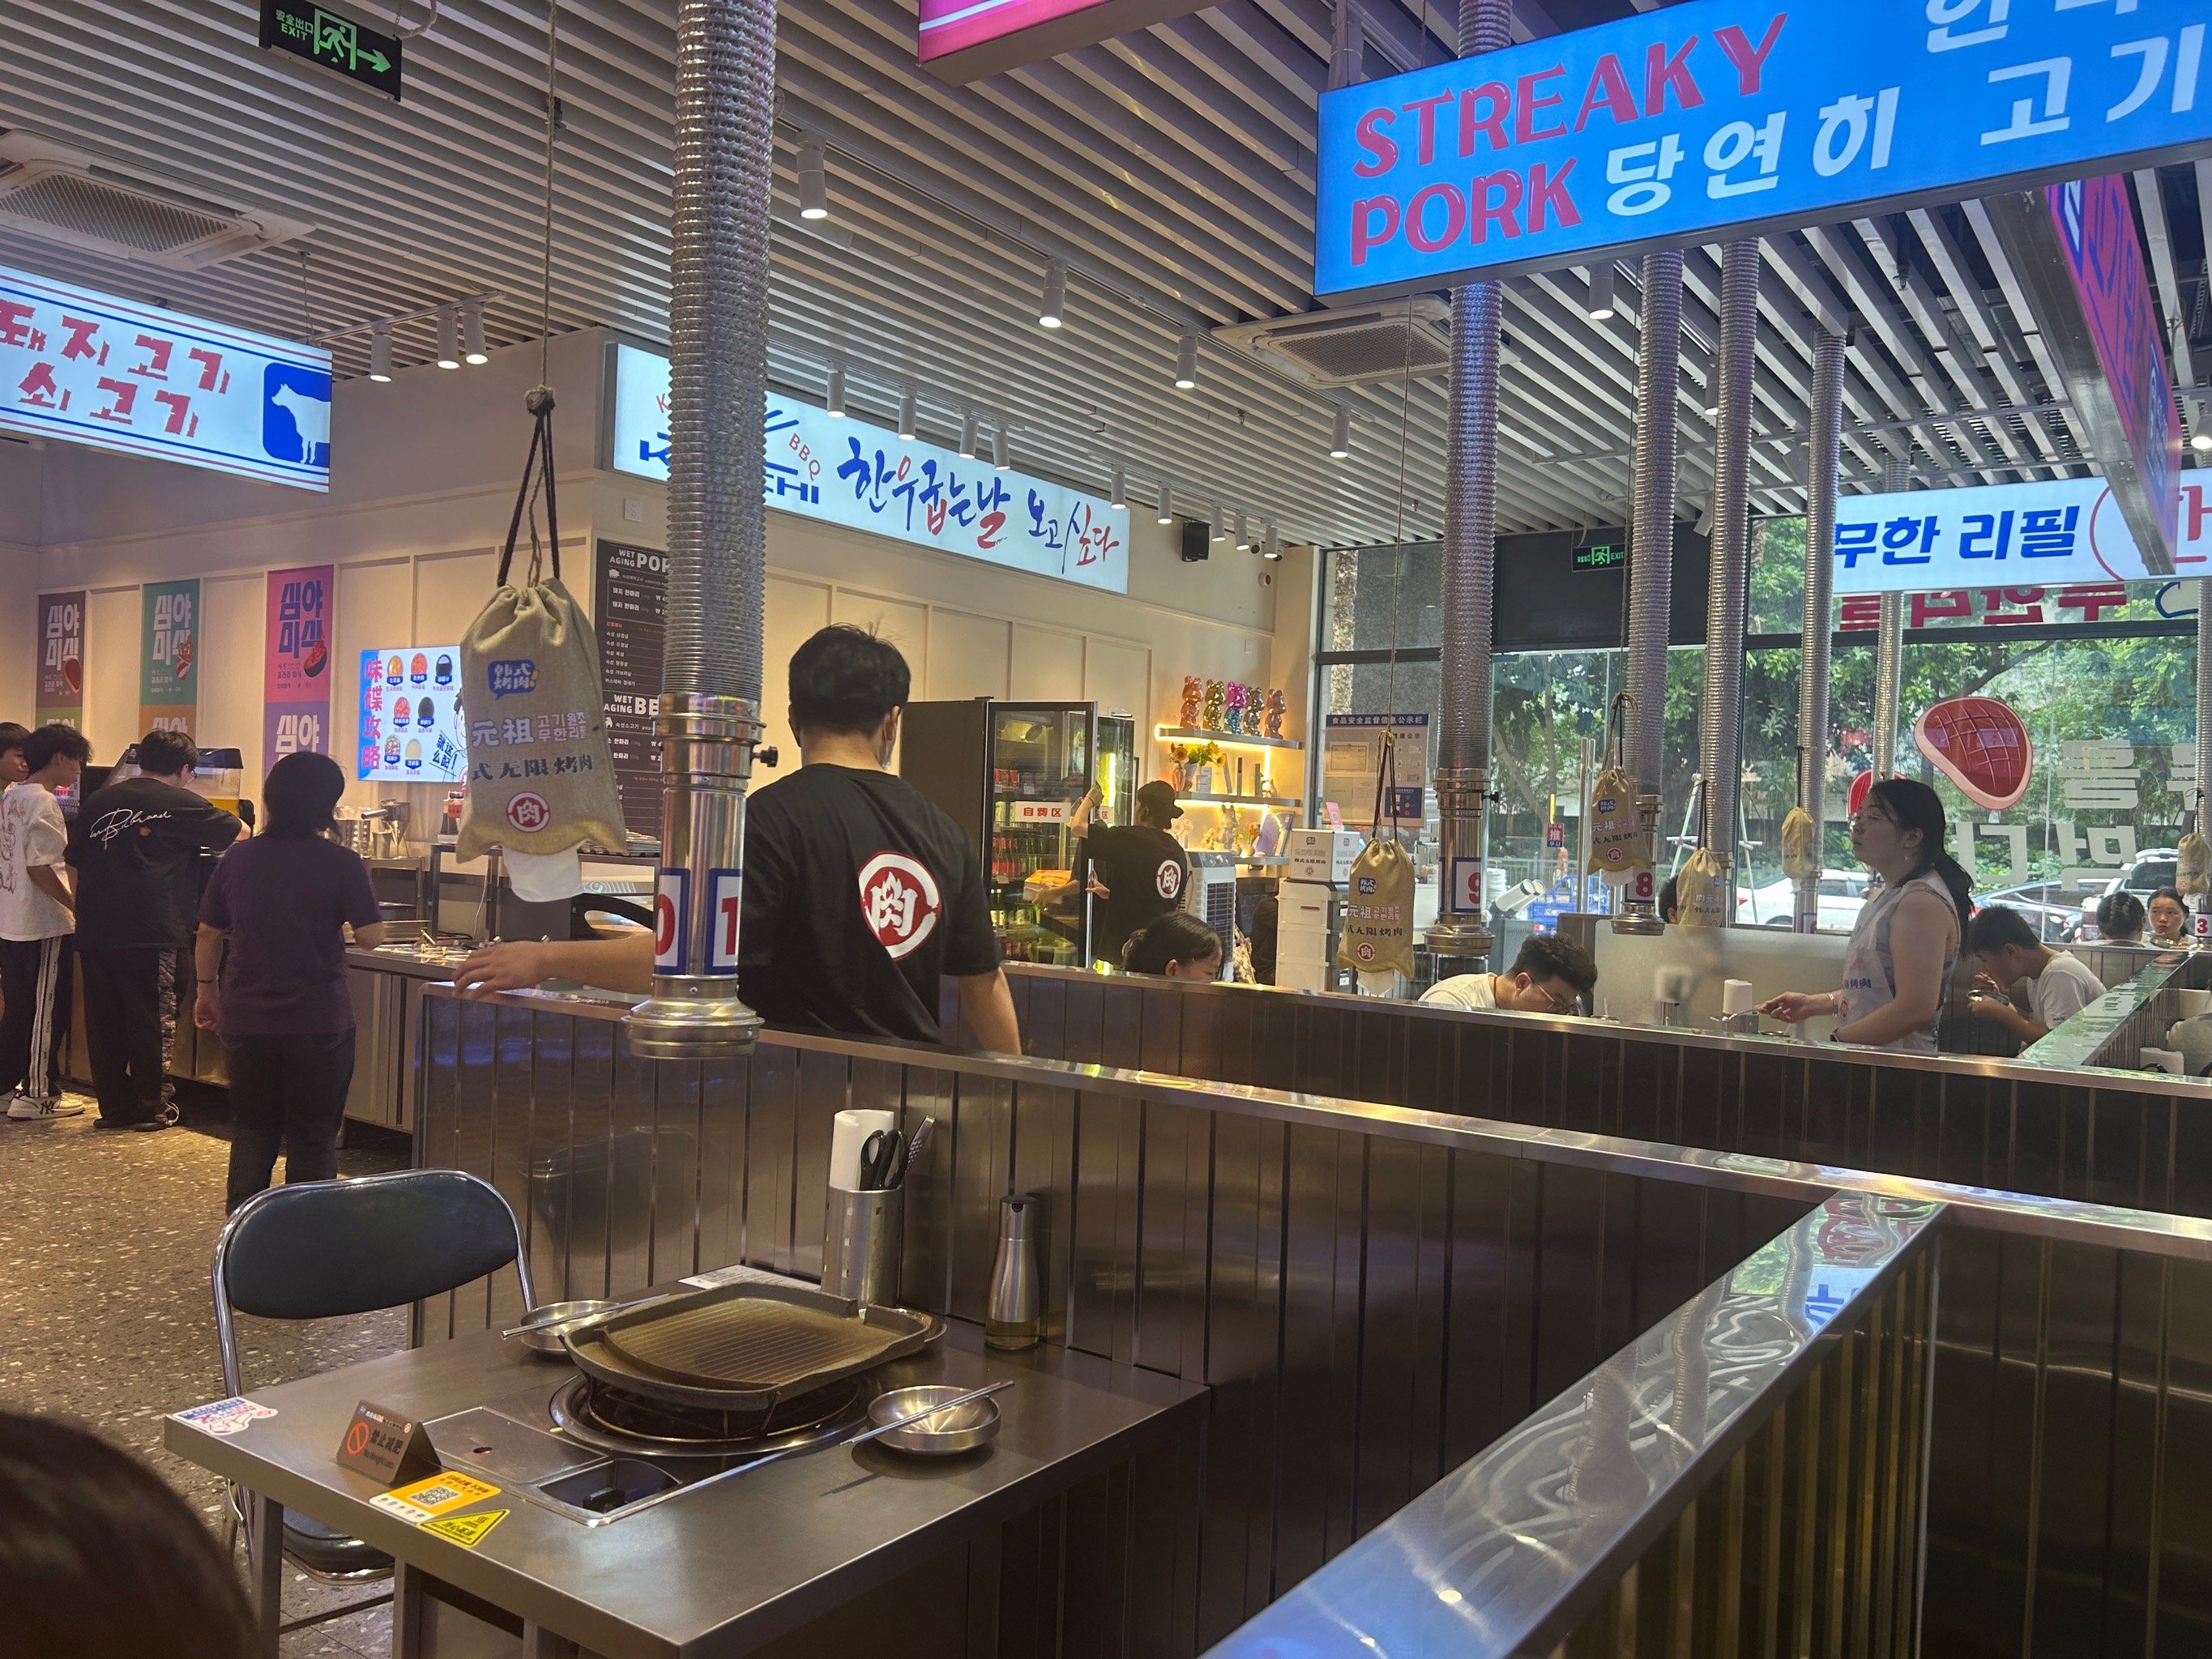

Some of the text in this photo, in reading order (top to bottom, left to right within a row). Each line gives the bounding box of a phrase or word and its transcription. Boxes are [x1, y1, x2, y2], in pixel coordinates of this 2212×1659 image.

[276, 9, 314, 35] 安全出口
[281, 23, 308, 41] EXIT
[1353, 13, 1787, 177] STREAKY
[1980, 23, 2206, 146] 고기
[1606, 86, 1900, 216] 당연히
[1351, 157, 1582, 267] PORK
[788, 432, 821, 481] BBQ
[1834, 505, 2080, 569] 무한 리필
[609, 557, 635, 567] AGING
[619, 548, 635, 558] WET
[1611, 552, 1625, 561] EXIT
[493, 663, 532, 677] 韩式
[604, 703, 632, 714] AGING
[613, 694, 633, 704] WET
[1332, 716, 1423, 725] 食品安全监督信息公示栏
[472, 718, 534, 746] 元祖
[472, 754, 593, 781] 式无限烤肉
[1023, 807, 1061, 817] 自费区
[1635, 872, 1653, 898] 8
[1348, 905, 1372, 919] 元祖
[2197, 918, 2208, 934] 3
[369, 1429, 404, 1455] 禁止减肥
